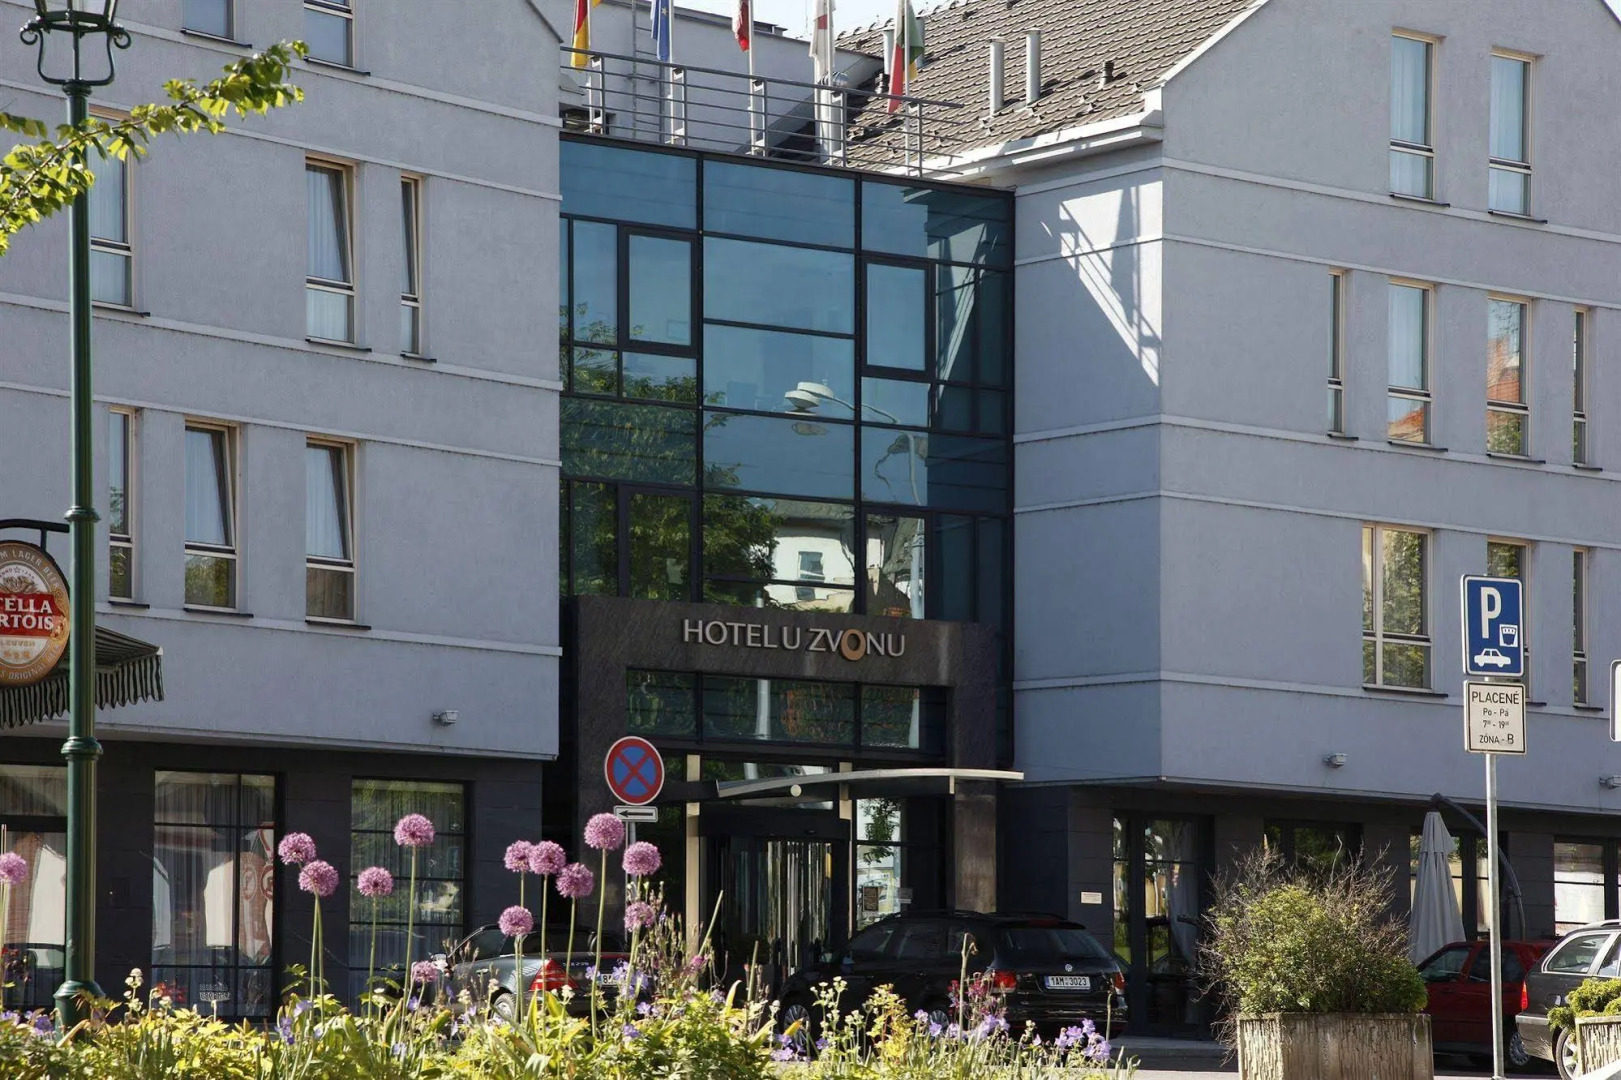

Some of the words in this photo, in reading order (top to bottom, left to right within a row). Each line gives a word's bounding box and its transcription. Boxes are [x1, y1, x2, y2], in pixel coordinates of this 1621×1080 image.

[1480, 586, 1502, 639] P
[684, 618, 778, 649] HOTEL
[782, 627, 801, 650] U
[807, 628, 906, 662] ZVONU
[1471, 690, 1520, 705] PLACENÉ
[1482, 707, 1493, 716] Po
[1479, 733, 1500, 744] ZÓNA
[1507, 733, 1515, 745] B
